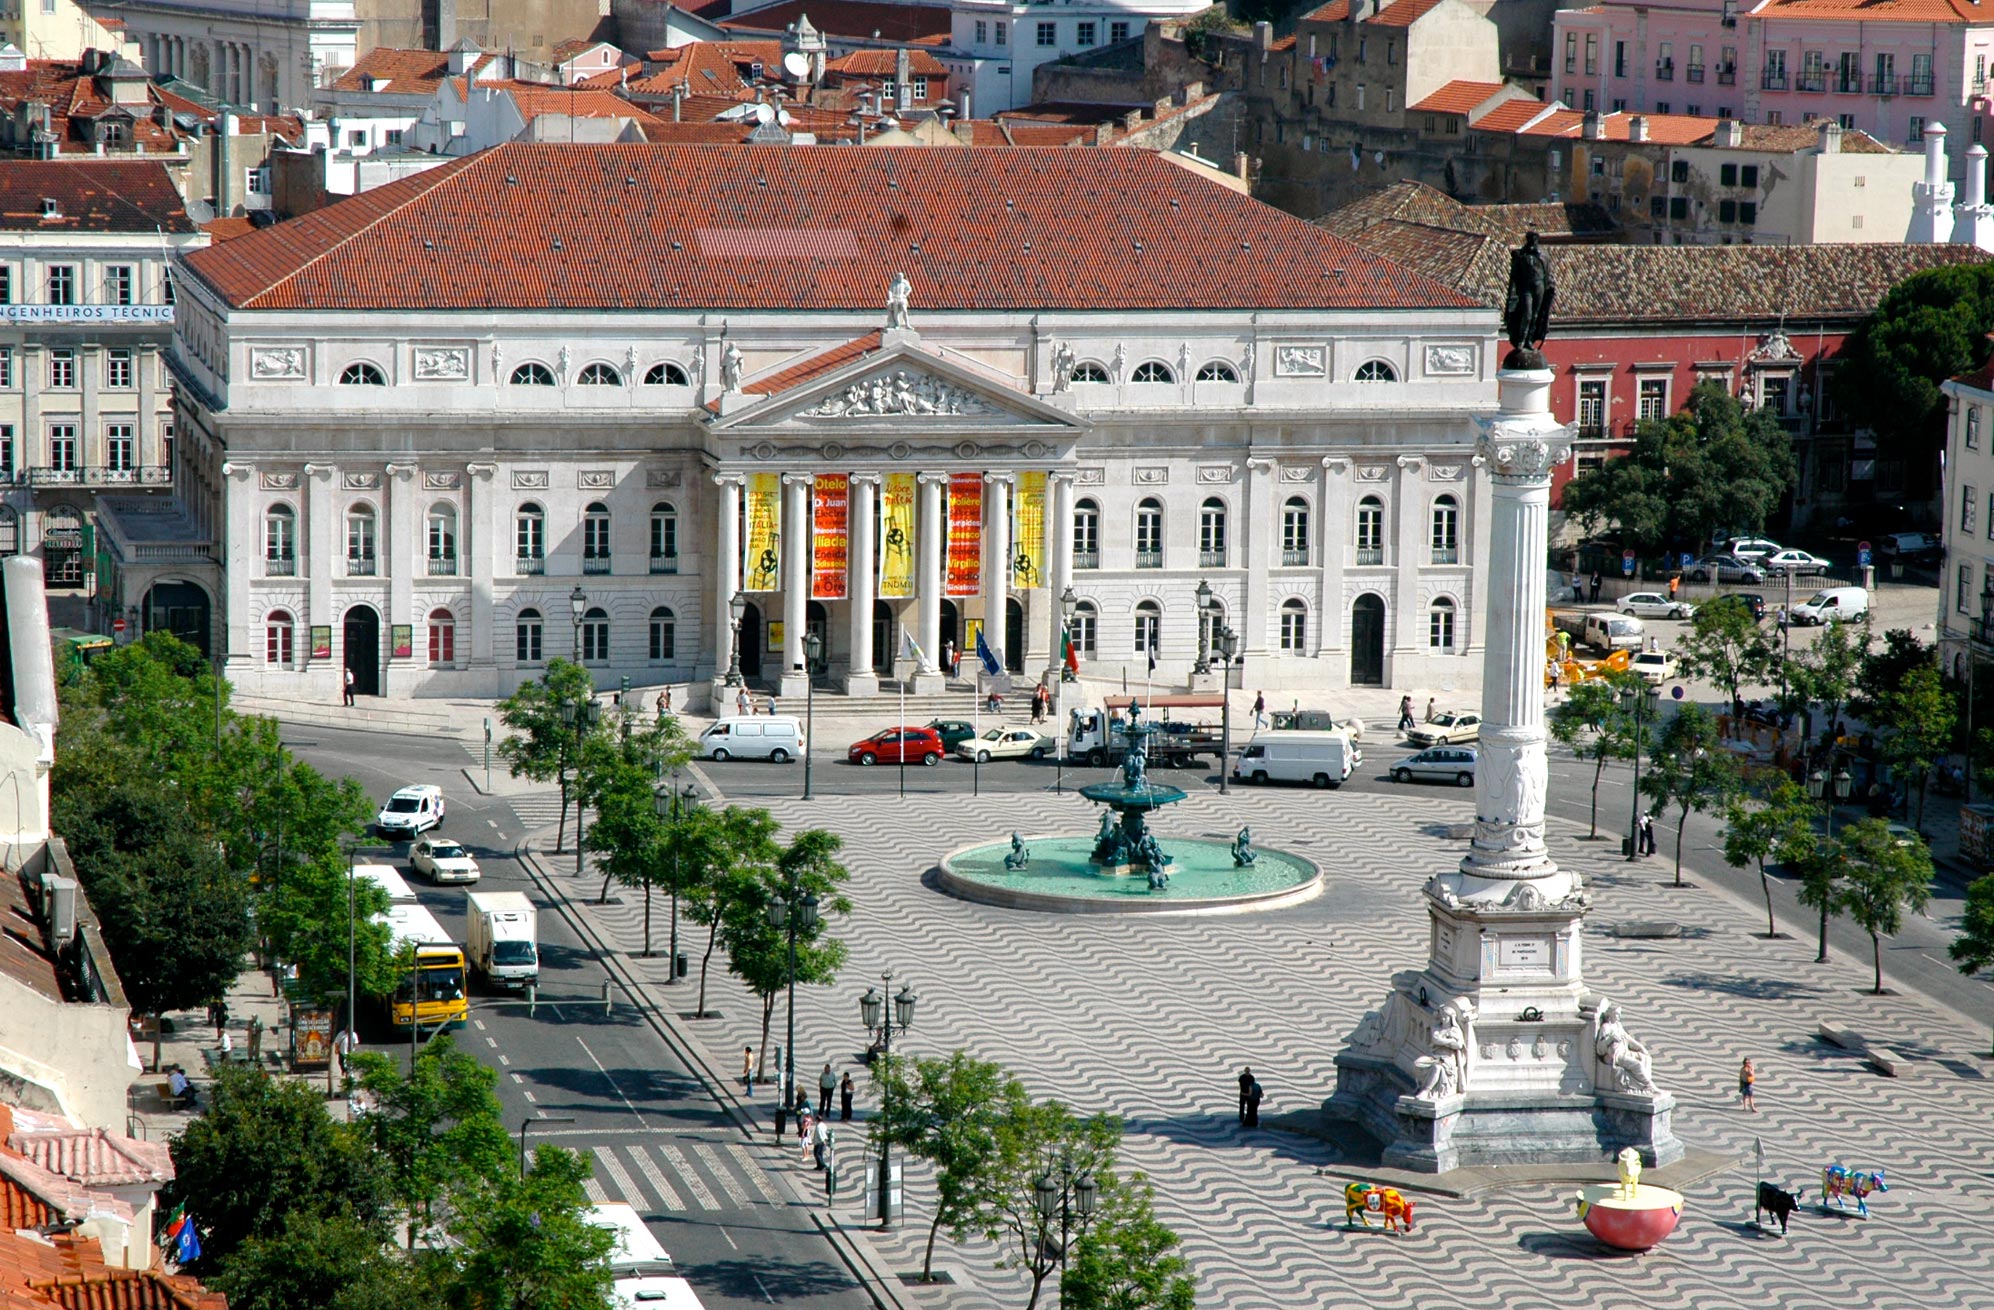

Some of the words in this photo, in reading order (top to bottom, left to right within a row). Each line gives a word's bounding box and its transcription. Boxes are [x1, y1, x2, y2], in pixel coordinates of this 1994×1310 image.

[112, 307, 175, 318] TÉCNIC
[814, 479, 847, 490] Otelo
[814, 498, 824, 507] D.
[826, 498, 847, 507] Juan
[949, 497, 981, 505] Molière
